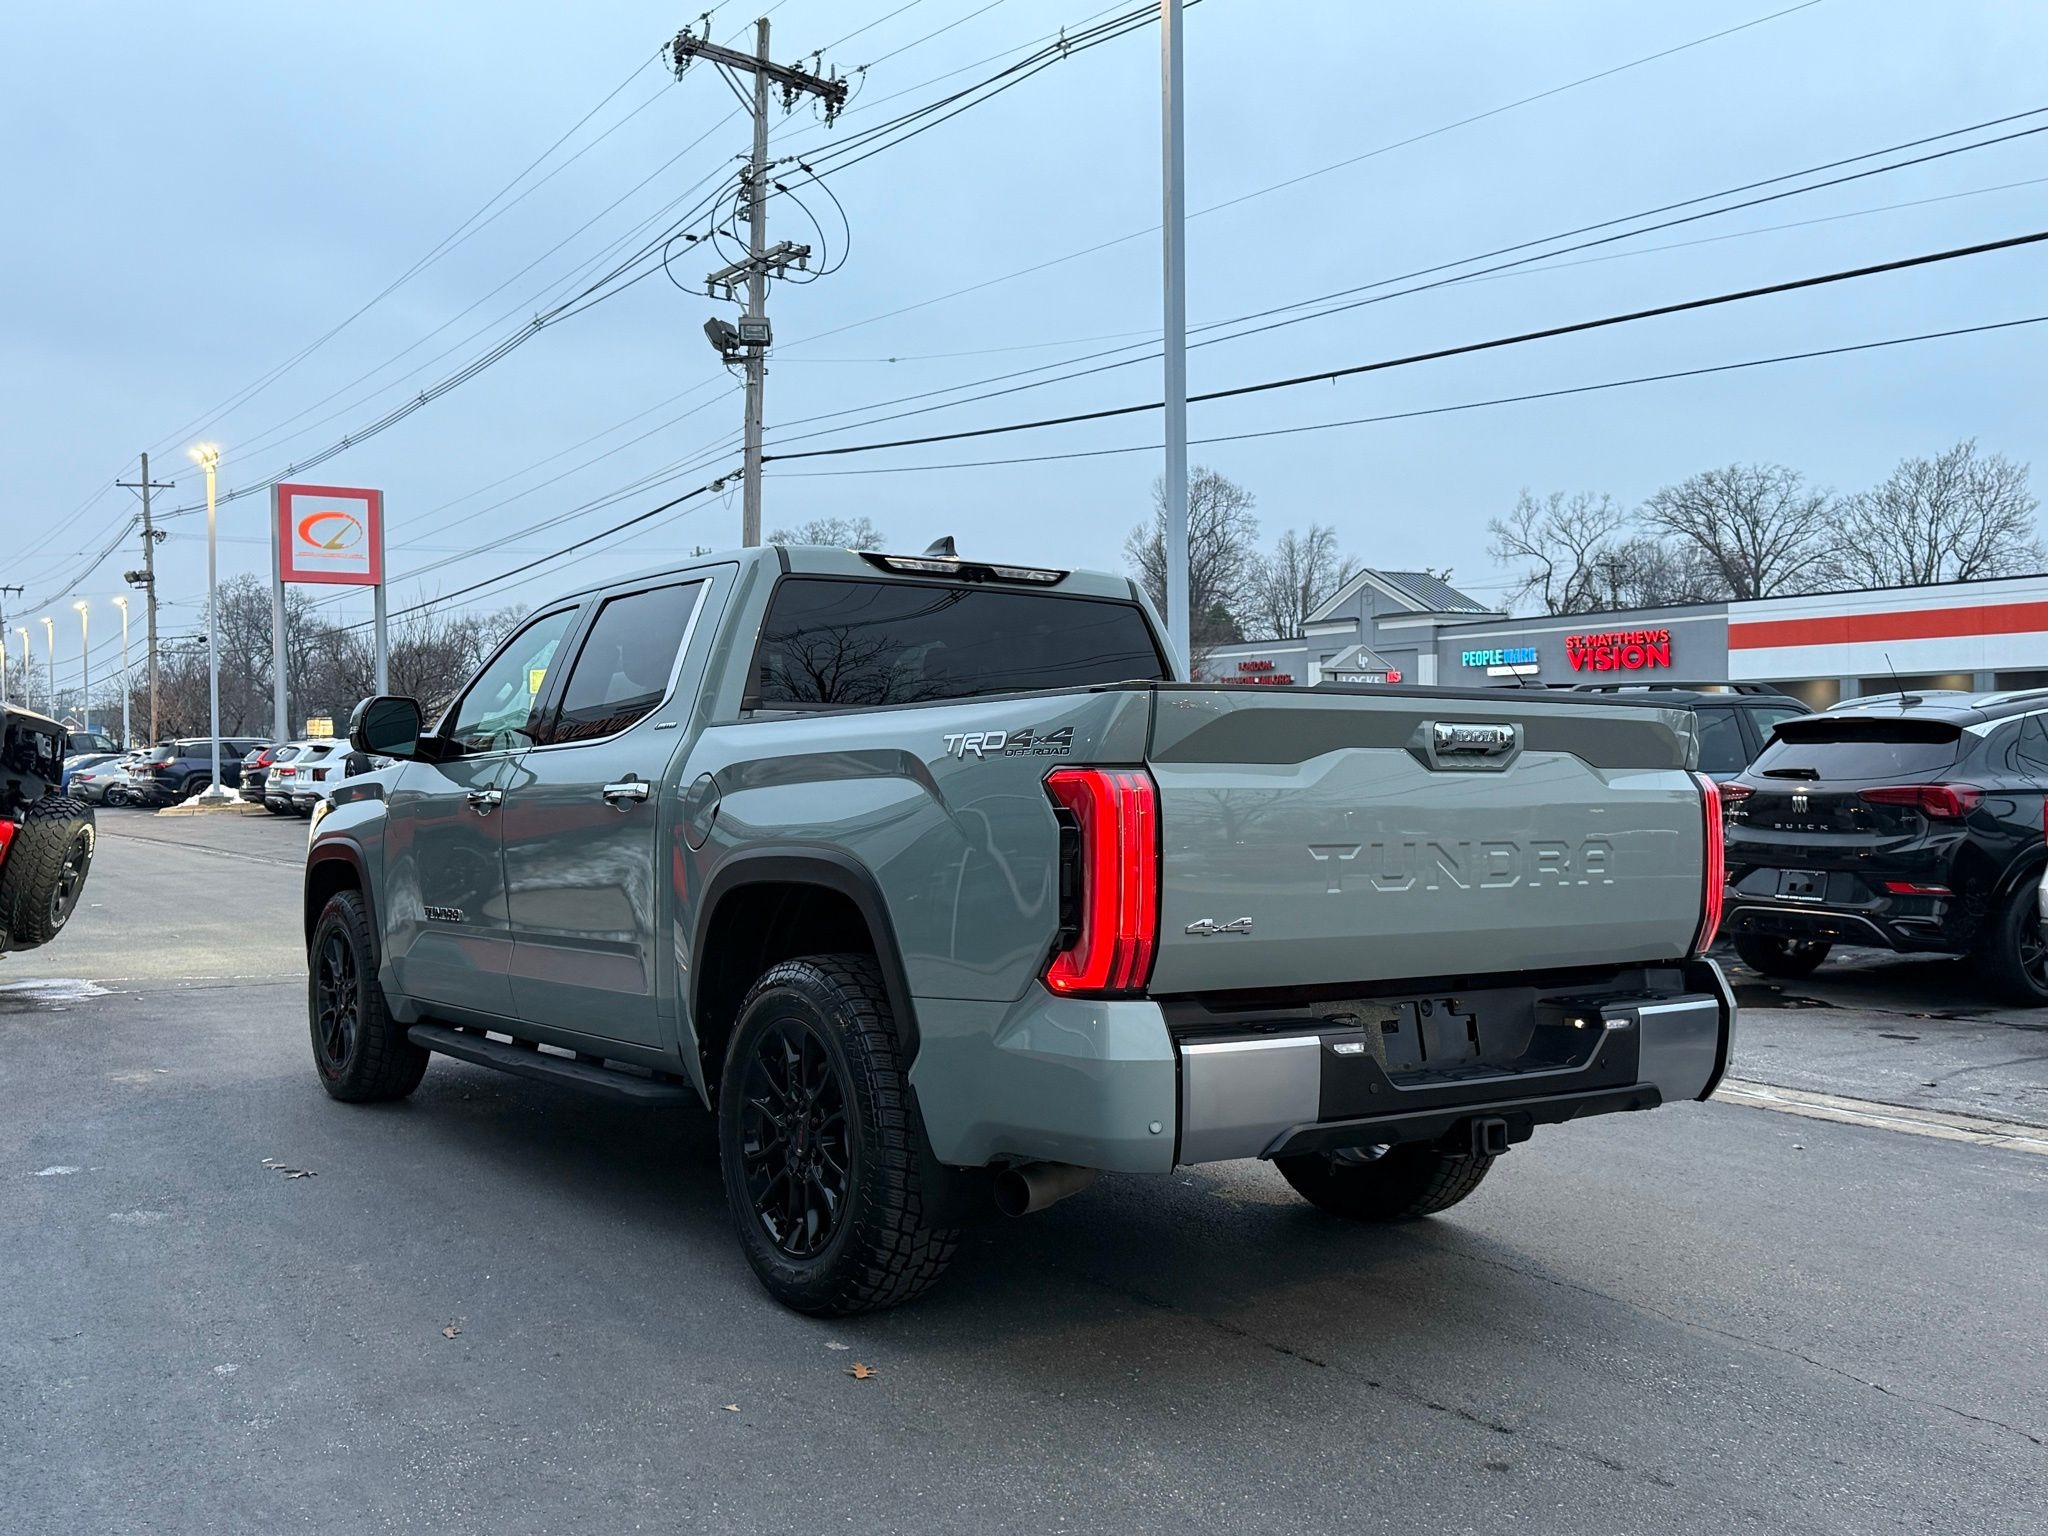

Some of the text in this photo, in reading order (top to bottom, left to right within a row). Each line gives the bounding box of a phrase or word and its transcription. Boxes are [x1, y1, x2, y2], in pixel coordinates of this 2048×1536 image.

[1565, 629, 1670, 649] ST. MATTHEWS
[1566, 643, 1671, 672] VISION
[943, 730, 1008, 760] TRD
[1456, 729, 1497, 743] TOYOTA
[1004, 746, 1070, 758] OFF ROAD
[1774, 822, 1829, 831] BUICK
[1307, 839, 1614, 894] TUNDRA
